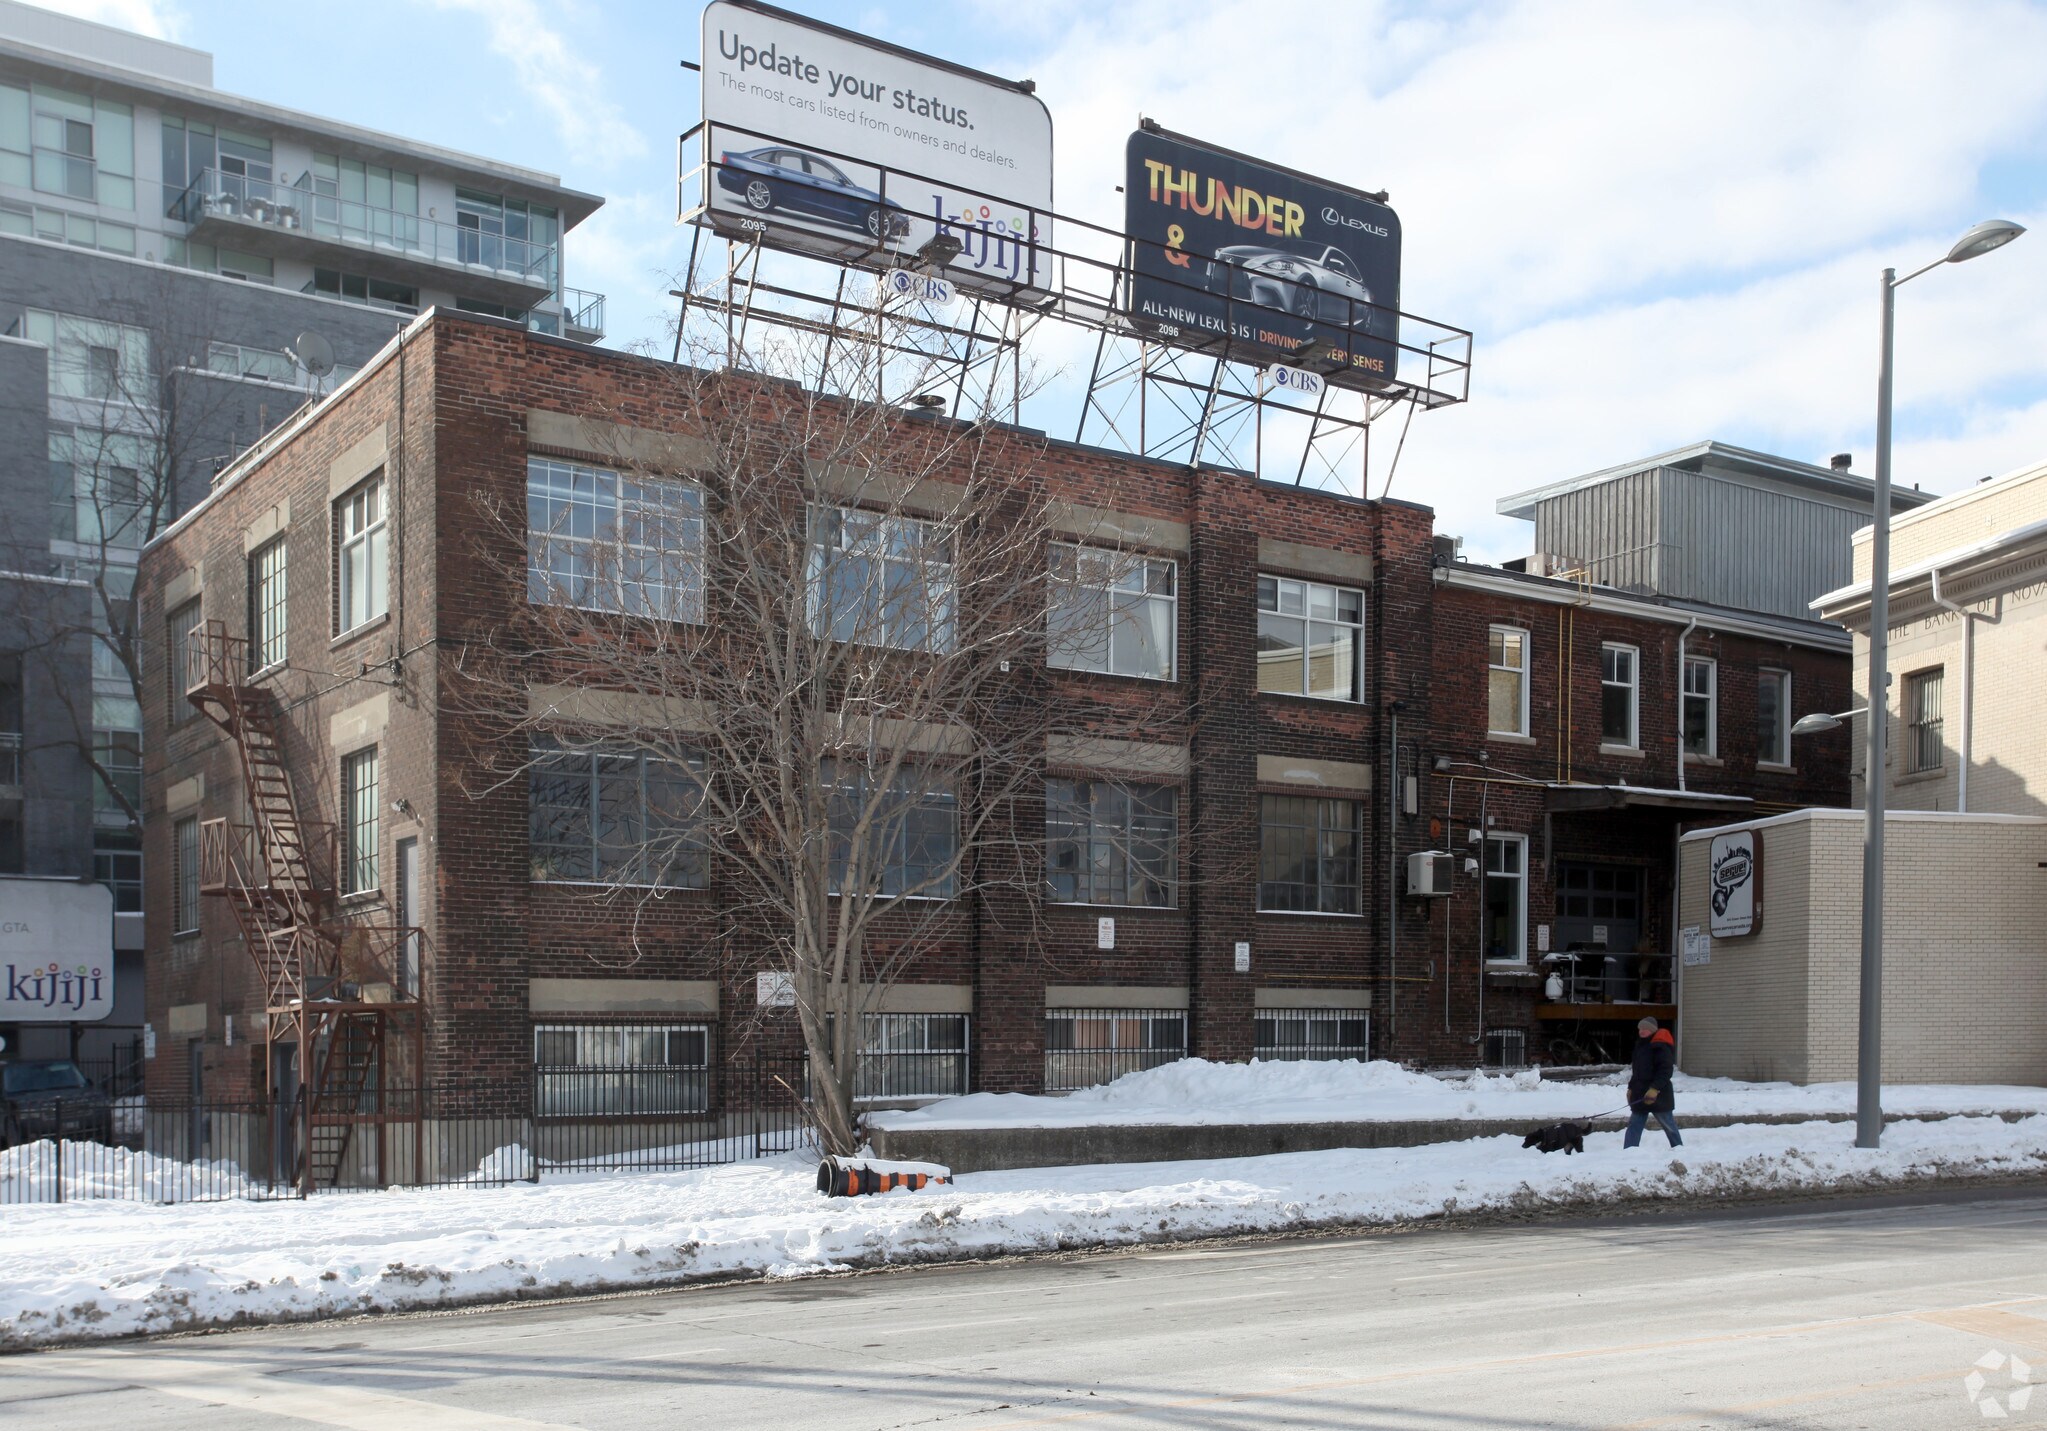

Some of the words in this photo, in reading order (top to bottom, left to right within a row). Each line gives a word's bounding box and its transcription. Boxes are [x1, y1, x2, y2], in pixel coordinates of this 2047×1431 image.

[719, 30, 820, 84] Update
[828, 69, 886, 103] your
[893, 89, 975, 130] status.
[719, 72, 746, 92] The
[751, 84, 785, 104] most
[788, 94, 816, 112] cars
[820, 102, 855, 123] listed
[859, 111, 890, 133] from
[893, 126, 939, 150] owners
[943, 136, 966, 155] and
[970, 142, 1018, 170] dealers.
[1144, 158, 1306, 239] THUNDER
[740, 218, 767, 232] 2095
[932, 195, 1040, 281] kijiji
[1164, 224, 1190, 269] &
[1340, 215, 1388, 237] LEXUS
[912, 274, 948, 302] CBS
[1142, 300, 1196, 324] ALL-NEW
[1199, 315, 1237, 335] LEXUS
[1239, 324, 1250, 338] IS
[1352, 354, 1384, 373] SENSE
[1158, 323, 1179, 337] 2096
[1290, 370, 1318, 393] CBS
[1887, 622, 1910, 640] THE
[1924, 610, 1960, 630] BANK
[1976, 599, 1992, 613] OF
[5, 963, 103, 1011] kijiji
